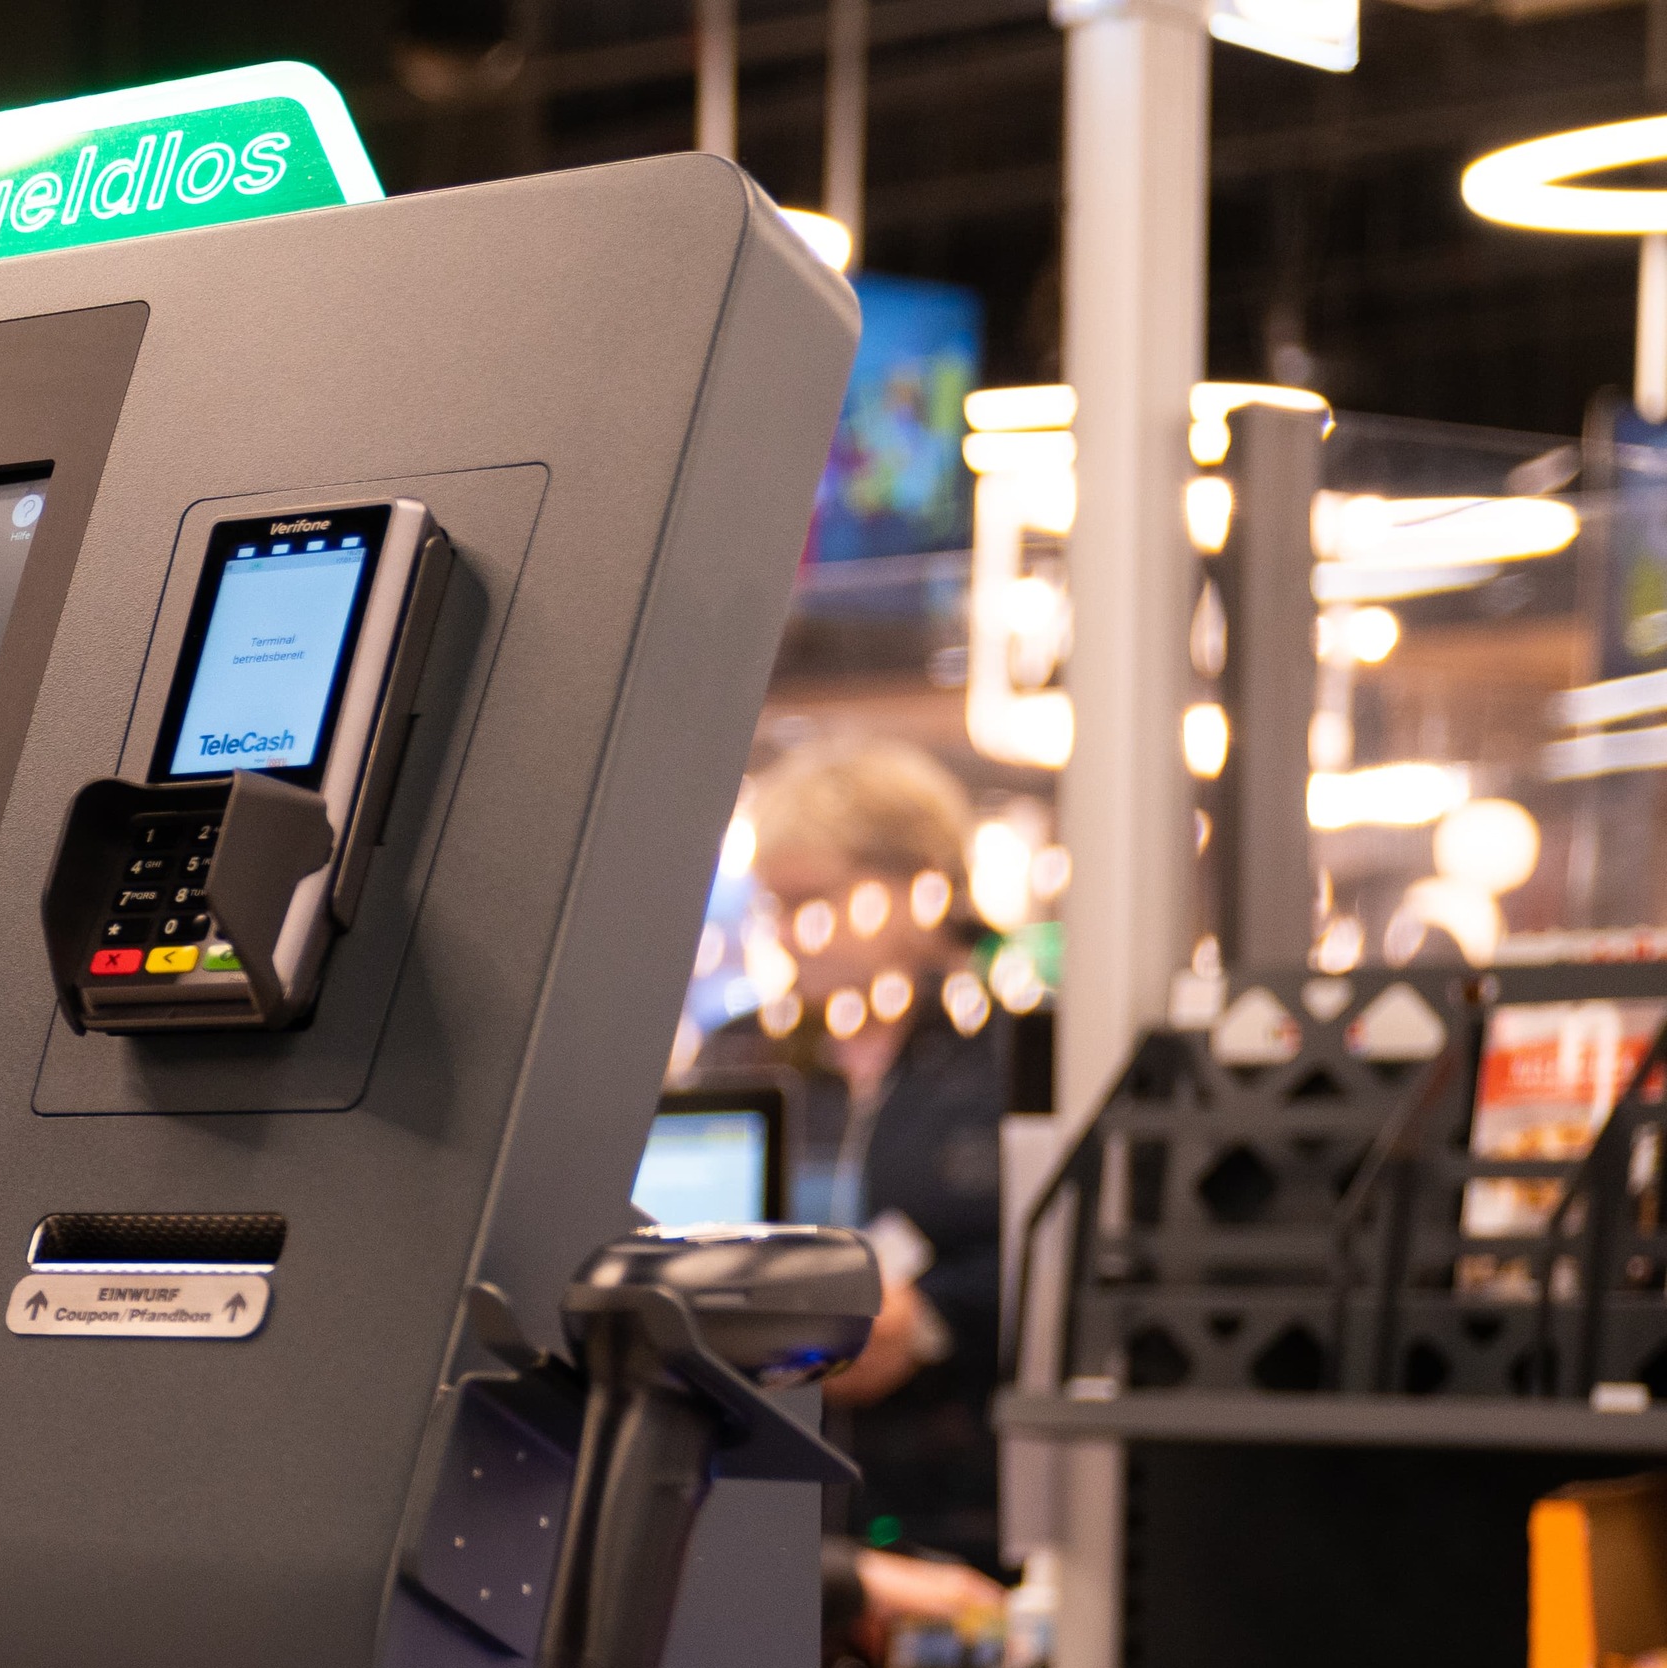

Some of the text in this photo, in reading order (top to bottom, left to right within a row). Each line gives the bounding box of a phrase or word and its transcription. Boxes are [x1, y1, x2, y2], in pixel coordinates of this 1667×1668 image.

[269, 519, 331, 536] Verifone
[251, 633, 296, 647] Terminal
[233, 650, 305, 665] betriebsbereit
[199, 729, 295, 756] TeleCash
[97, 1287, 181, 1302] EINWURF
